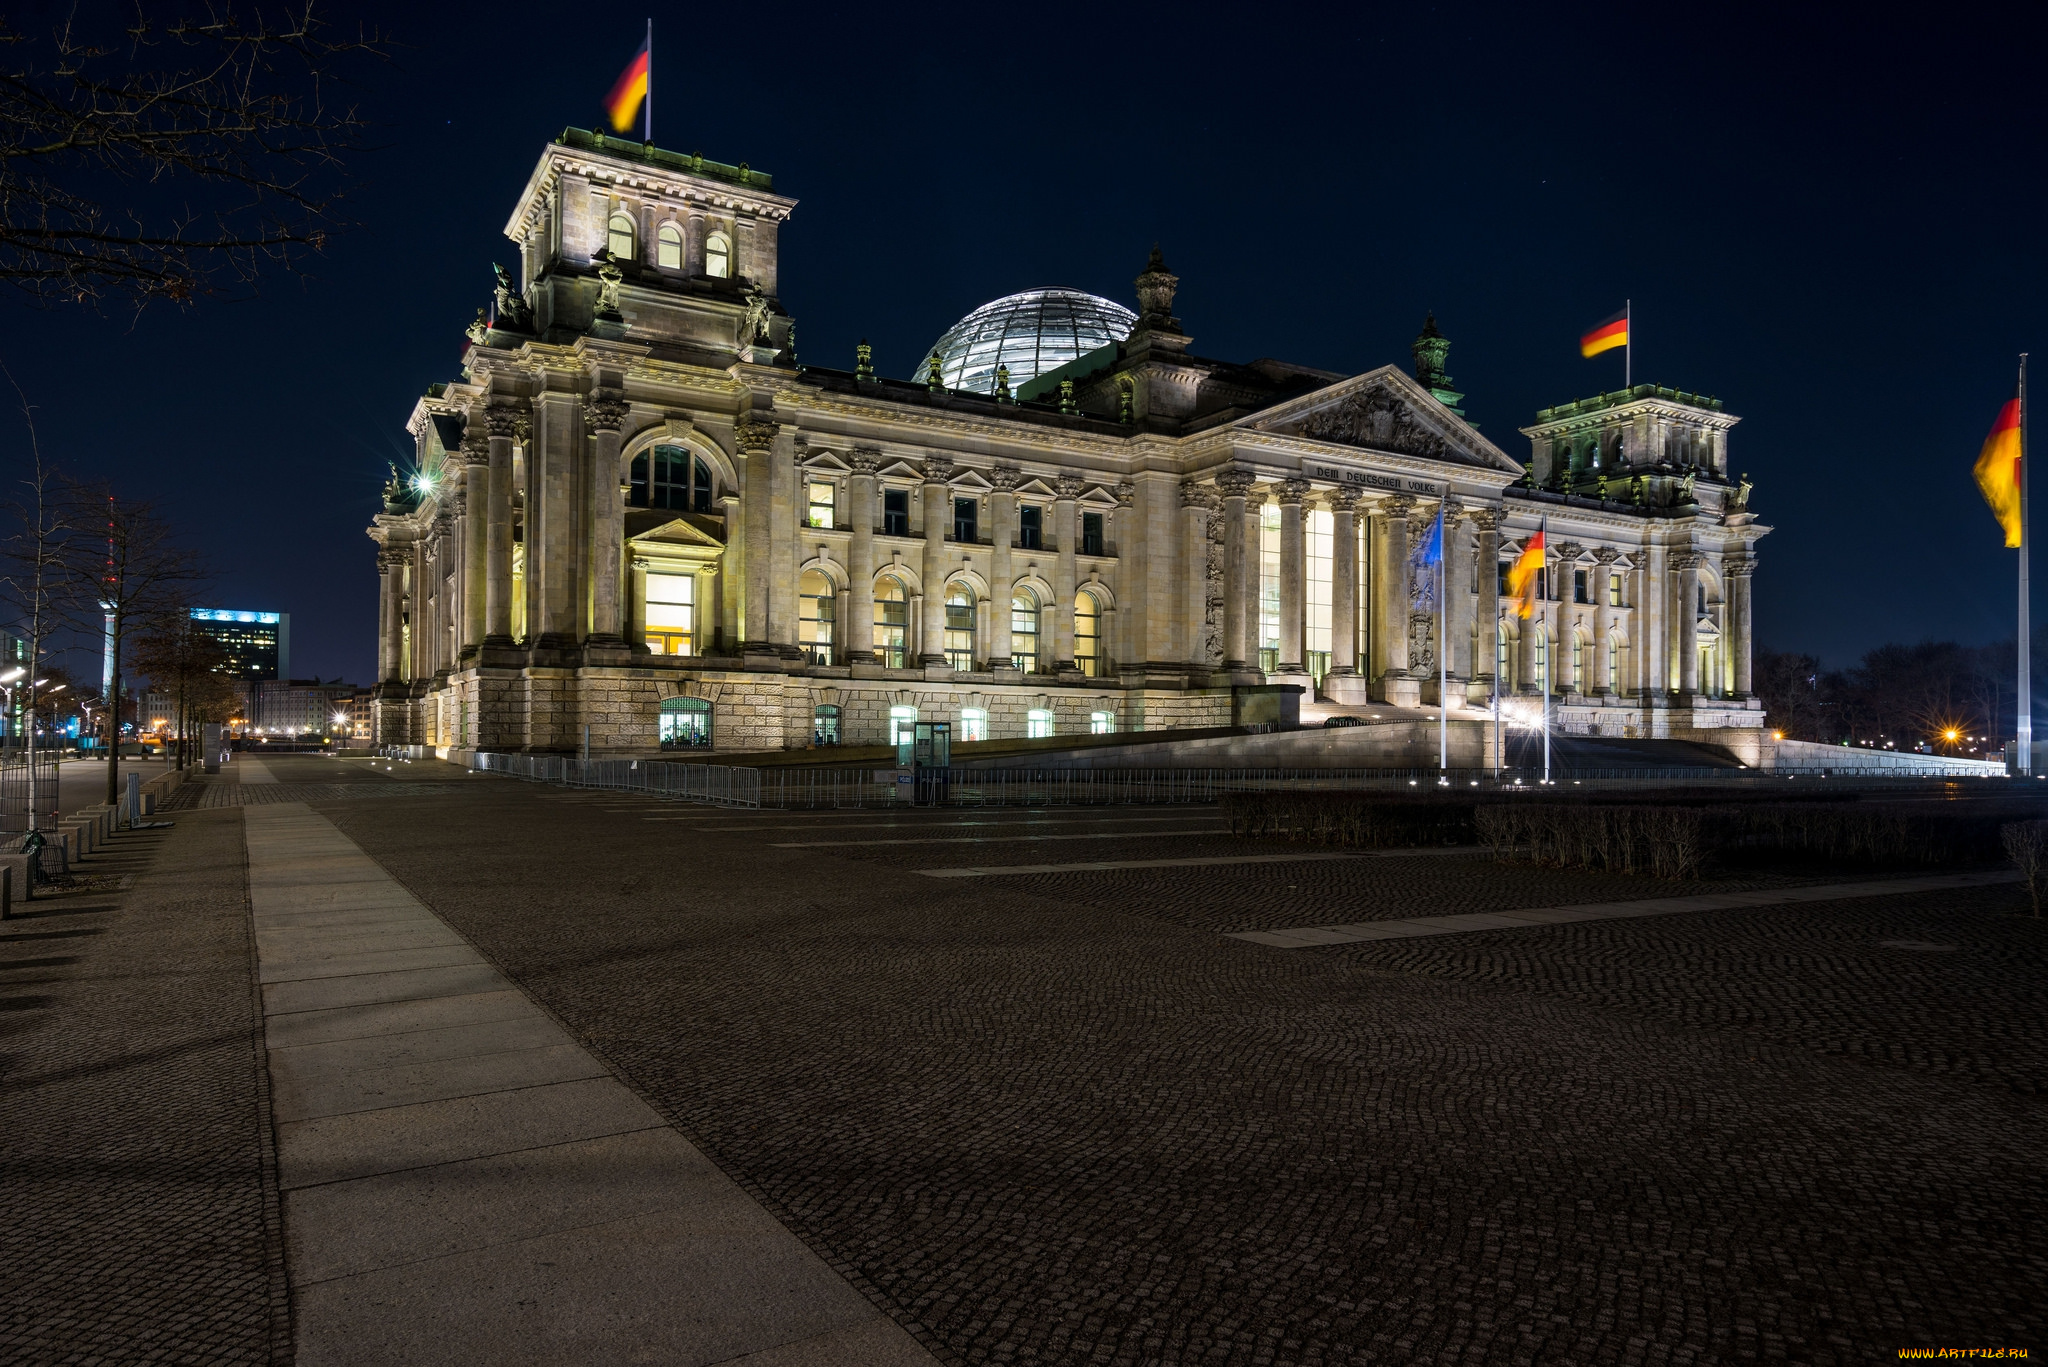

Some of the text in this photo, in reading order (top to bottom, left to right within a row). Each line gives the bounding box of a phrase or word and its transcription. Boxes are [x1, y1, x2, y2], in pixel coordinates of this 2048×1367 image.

[1317, 467, 1435, 493] DEM DEUTSCHEN VOLKE
